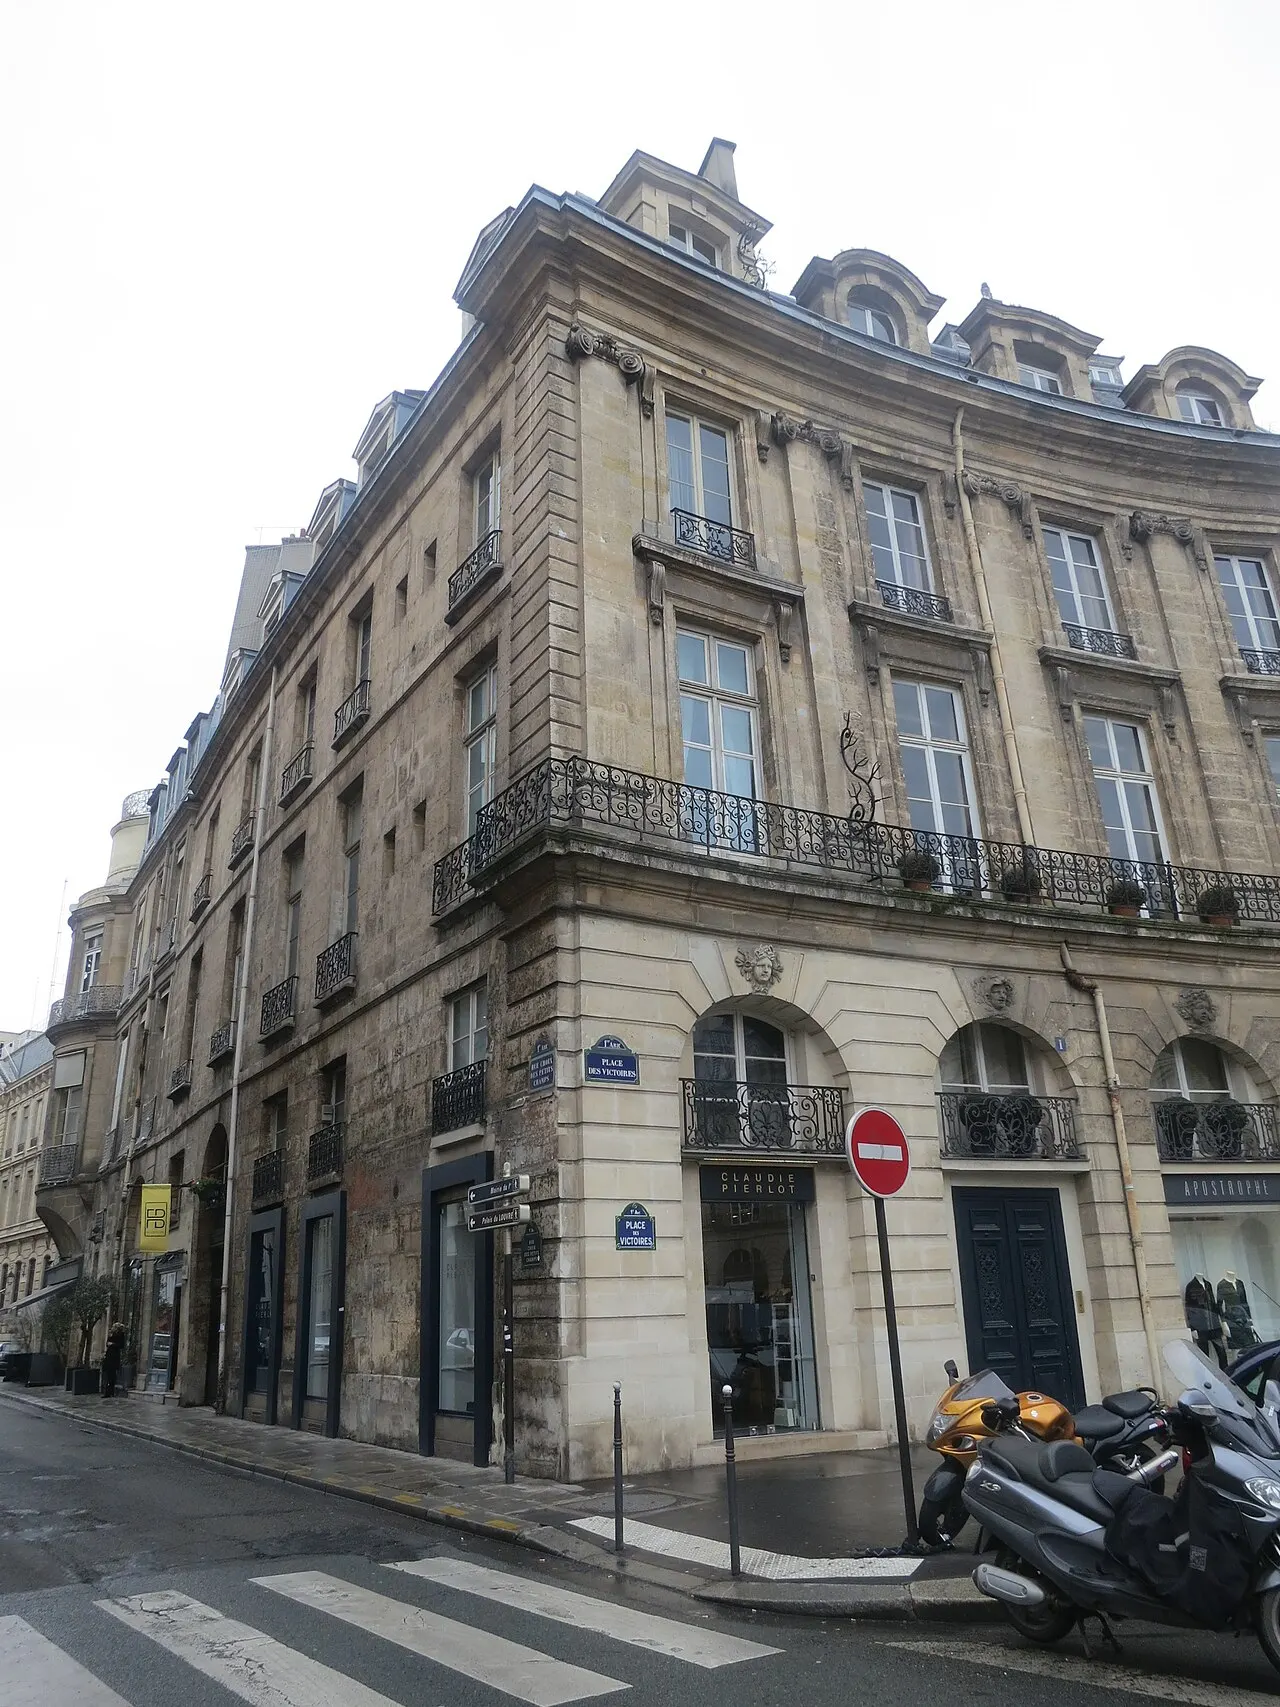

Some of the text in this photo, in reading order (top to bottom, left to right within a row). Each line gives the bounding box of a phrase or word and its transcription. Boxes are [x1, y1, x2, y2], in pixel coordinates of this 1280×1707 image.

[601, 1058, 624, 1067] PLACE
[588, 1067, 636, 1078] DES VICTOIRES
[721, 1172, 795, 1183] CLAUDIE
[721, 1184, 795, 1194] PIERLOT
[1184, 1180, 1269, 1196] APOSTROPHE
[498, 1211, 514, 1222] LOUVRE
[625, 1221, 646, 1230] PLACE
[619, 1236, 653, 1246] VICTOIRES
